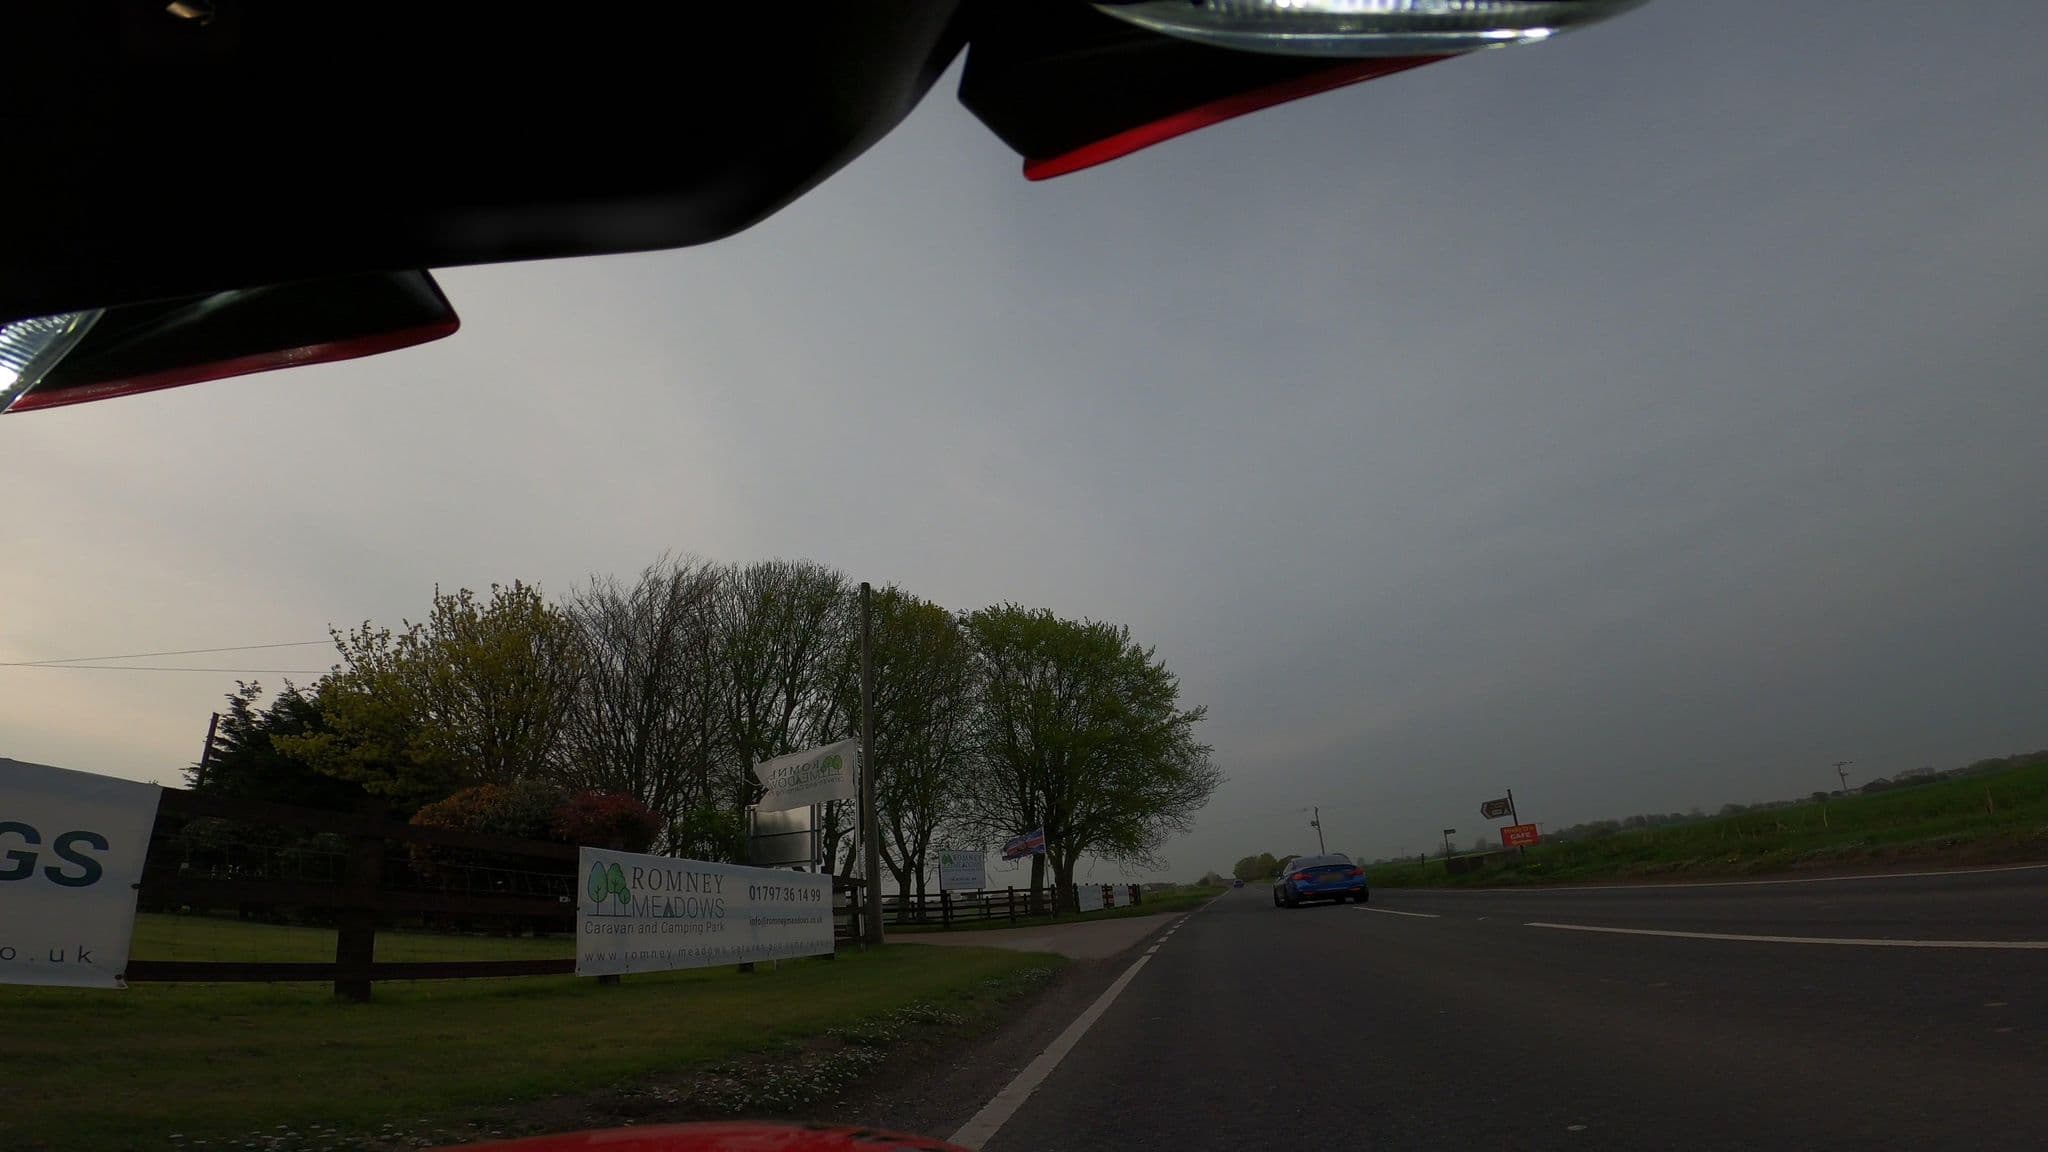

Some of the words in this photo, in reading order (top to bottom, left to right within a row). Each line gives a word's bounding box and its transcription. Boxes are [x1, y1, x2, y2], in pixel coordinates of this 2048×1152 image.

[631, 866, 723, 894] ROMNEY
[749, 885, 781, 901] 01797
[783, 887, 795, 902] 36
[798, 888, 809, 902] 14
[811, 889, 821, 902] 99
[631, 894, 726, 919] MEADOWS
[585, 920, 633, 934] Caravan
[638, 922, 657, 934] and
[661, 921, 703, 937] Camping
[706, 921, 724, 933] Park
